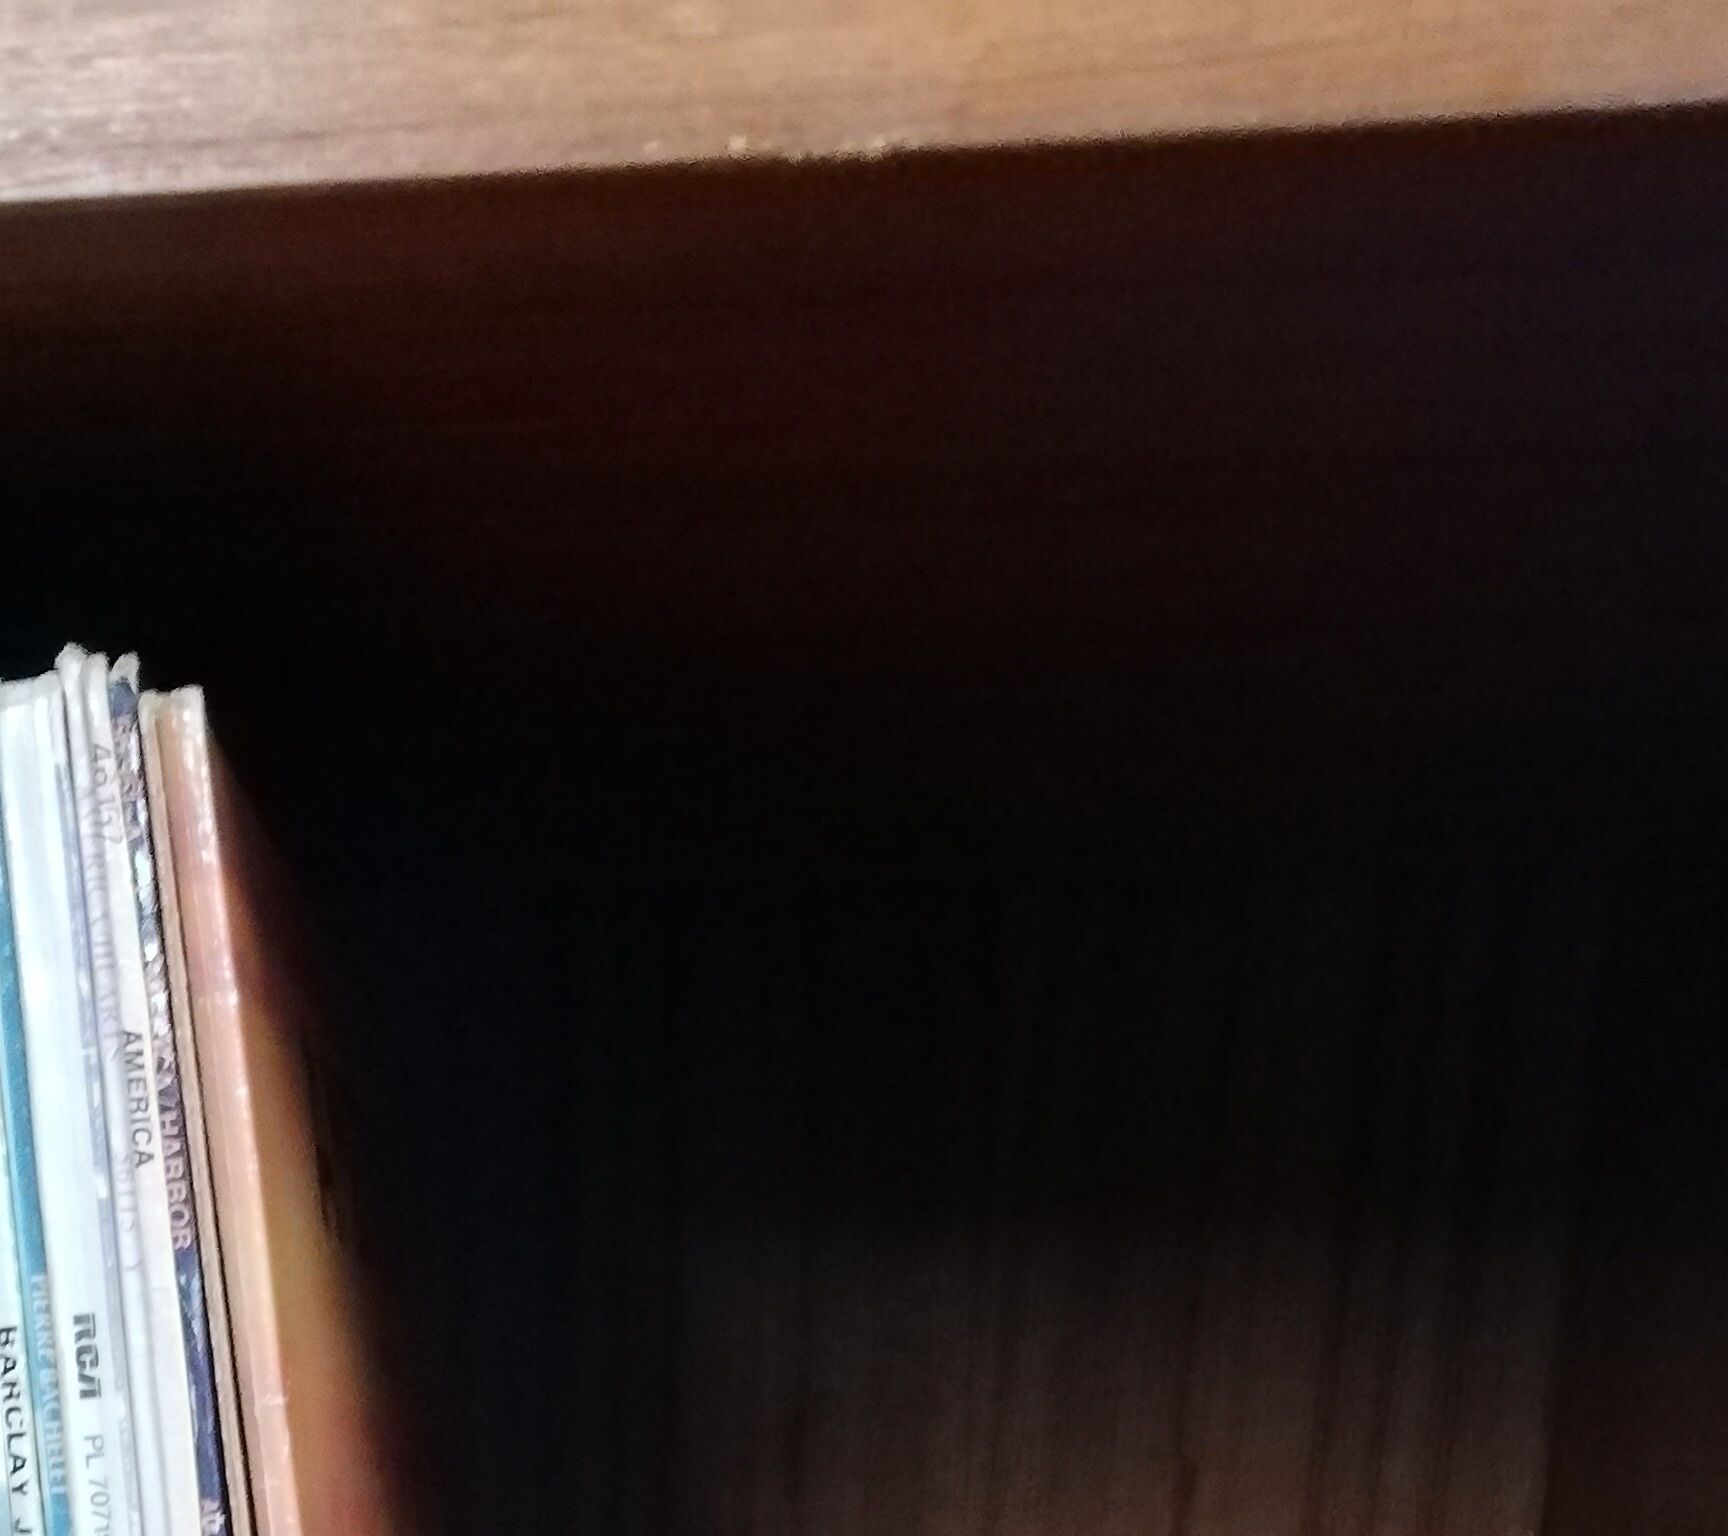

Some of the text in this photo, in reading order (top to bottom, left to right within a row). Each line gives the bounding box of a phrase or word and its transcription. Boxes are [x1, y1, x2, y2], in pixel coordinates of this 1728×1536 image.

[118, 1029, 157, 1169] AMERICA
[69, 1312, 104, 1400] RCA
[82, 1434, 107, 1469] PL
